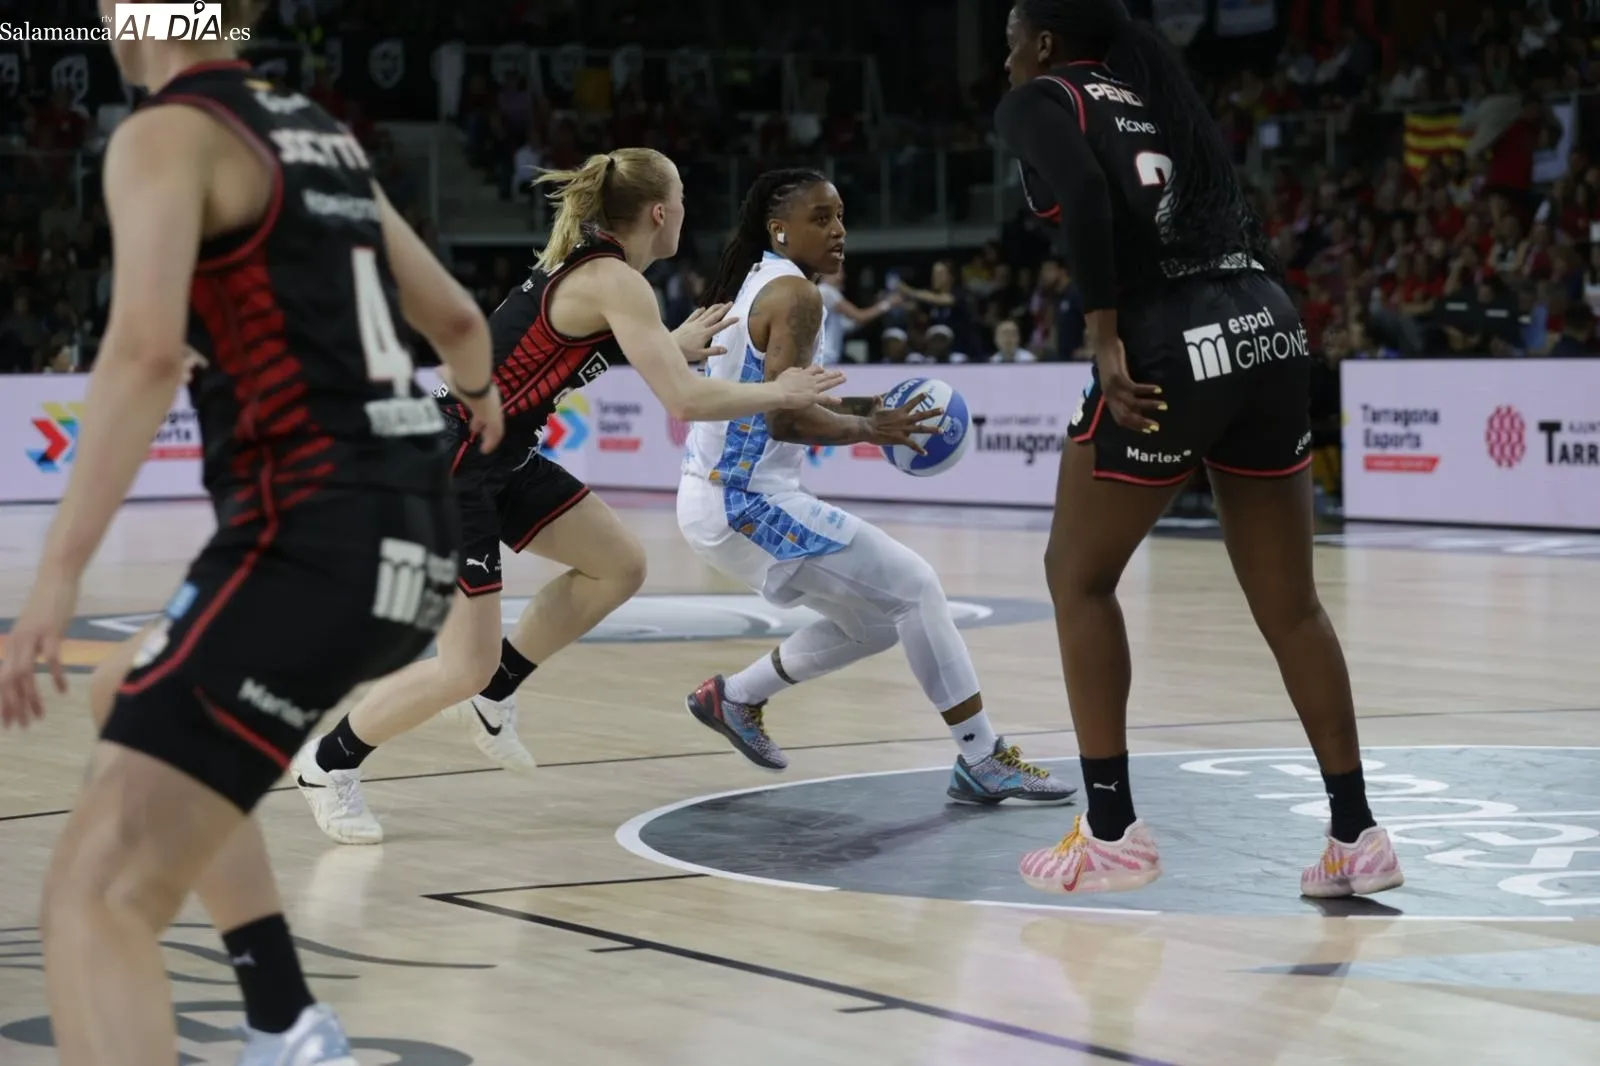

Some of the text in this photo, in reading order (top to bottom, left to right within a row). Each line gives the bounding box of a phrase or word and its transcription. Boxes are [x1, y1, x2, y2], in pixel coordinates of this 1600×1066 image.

[351, 246, 413, 398] 4
[1228, 306, 1275, 335] espai
[1361, 404, 1440, 427] Tarragona
[1363, 428, 1422, 451] Esports
[1126, 446, 1182, 463] Marlex
